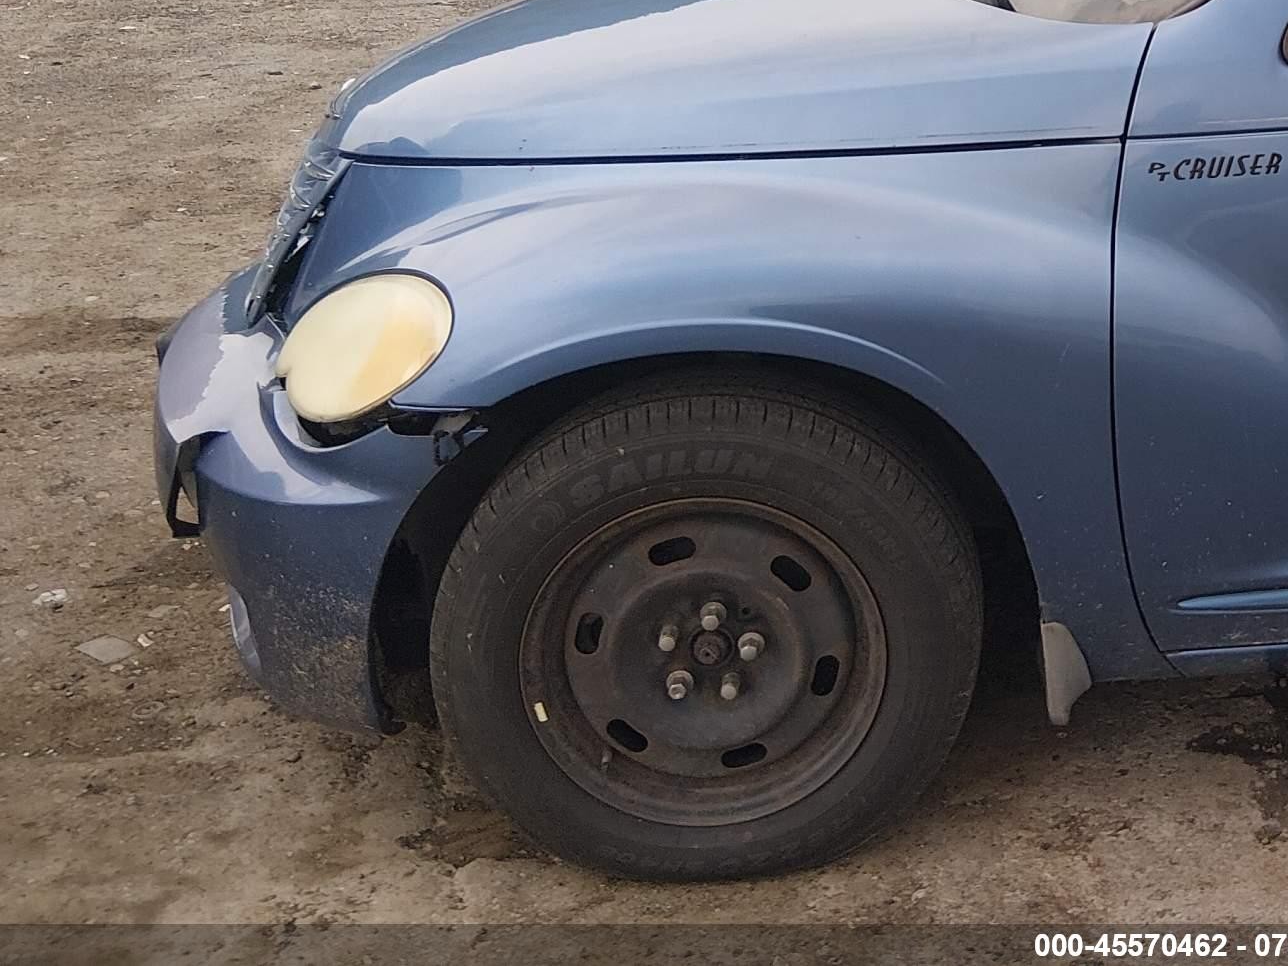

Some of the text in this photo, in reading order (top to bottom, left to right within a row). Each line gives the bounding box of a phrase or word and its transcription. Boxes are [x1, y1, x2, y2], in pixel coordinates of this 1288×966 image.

[1147, 152, 1283, 182] PT CRUISER
[567, 448, 775, 506] SAILUN
